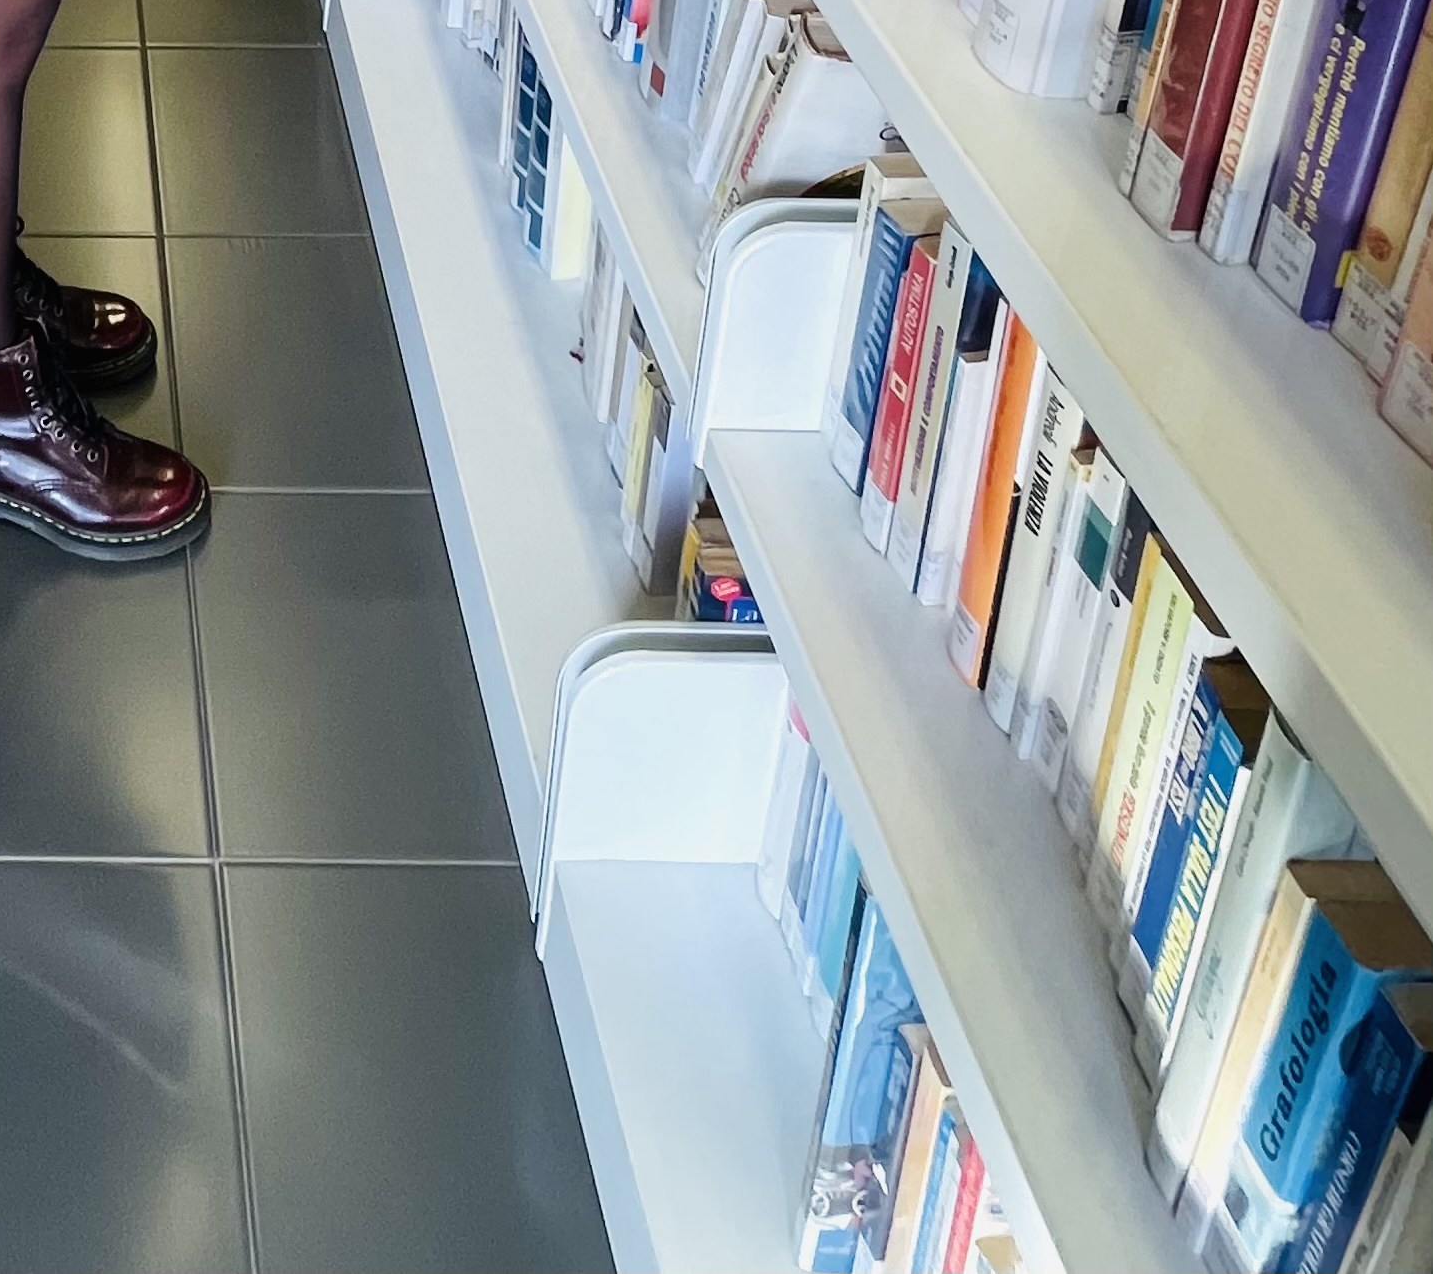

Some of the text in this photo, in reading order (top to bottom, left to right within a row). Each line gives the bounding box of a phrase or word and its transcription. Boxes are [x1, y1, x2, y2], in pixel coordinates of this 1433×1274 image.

[1242, 20, 1271, 103] SEGRETO
[1343, 35, 1367, 91] Perché
[1306, 56, 1335, 151] vergogniamo
[1323, 90, 1351, 169] mentiamo
[1309, 168, 1326, 197] con
[900, 272, 925, 357] AUTOSTIMA
[1040, 450, 1054, 469] LA
[1024, 466, 1051, 538] VIOLENZA
[1193, 794, 1225, 849] TEST
[1178, 841, 1213, 903] SULLA
[1259, 959, 1338, 1163] Grafologia
